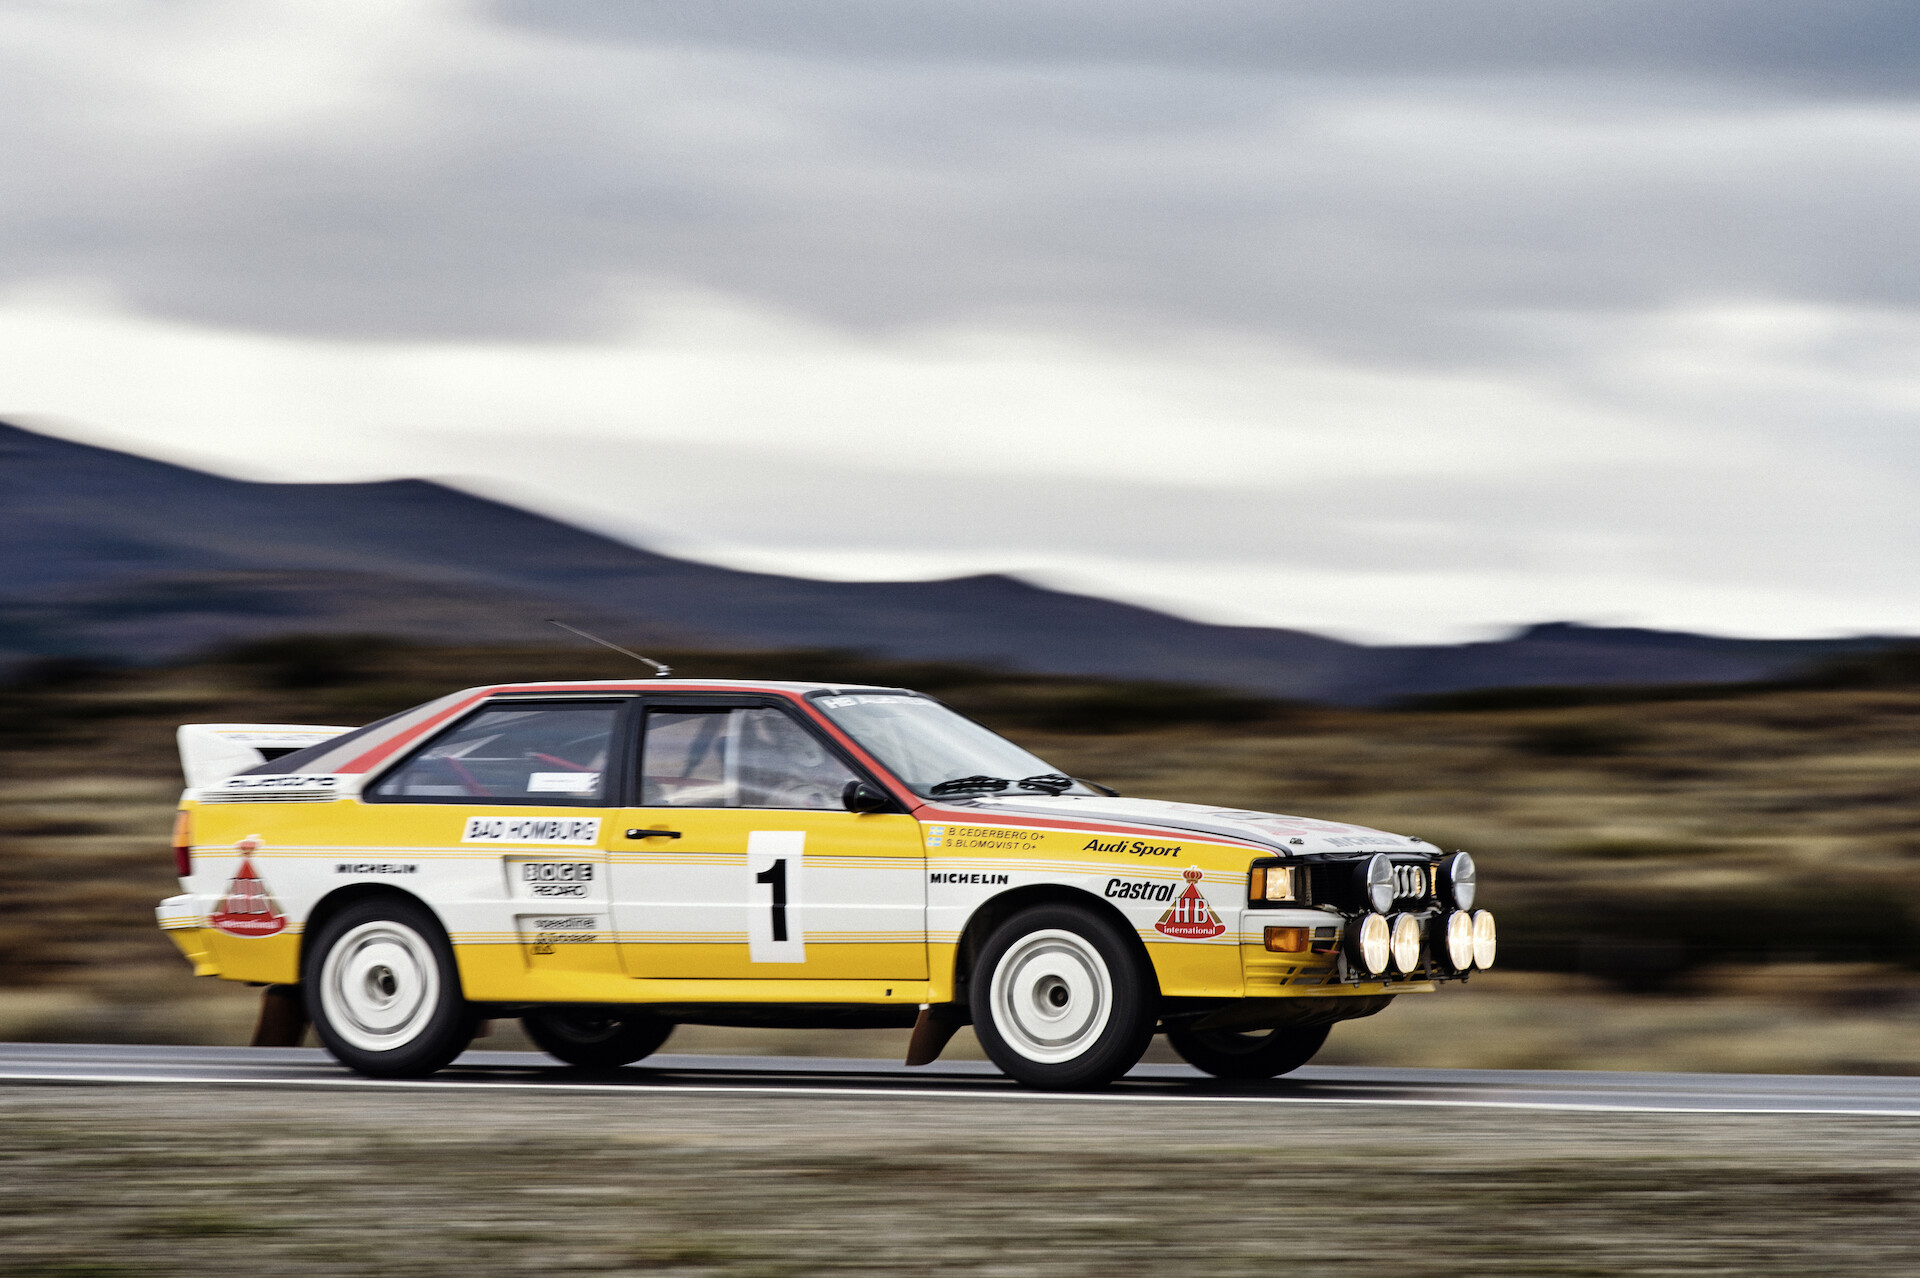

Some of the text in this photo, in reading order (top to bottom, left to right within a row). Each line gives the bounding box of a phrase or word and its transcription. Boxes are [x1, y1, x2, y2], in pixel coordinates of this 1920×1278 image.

[470, 820, 597, 841] BAD HOMBURG
[1082, 839, 1181, 857] Audi Sport
[334, 864, 420, 875] MICHELIN
[523, 864, 593, 881] BOGE
[930, 873, 1009, 885] MICHELIN
[1105, 878, 1176, 902] Castrol
[756, 859, 788, 941] 1
[1174, 897, 1209, 924] HB
[1163, 926, 1216, 935] international
